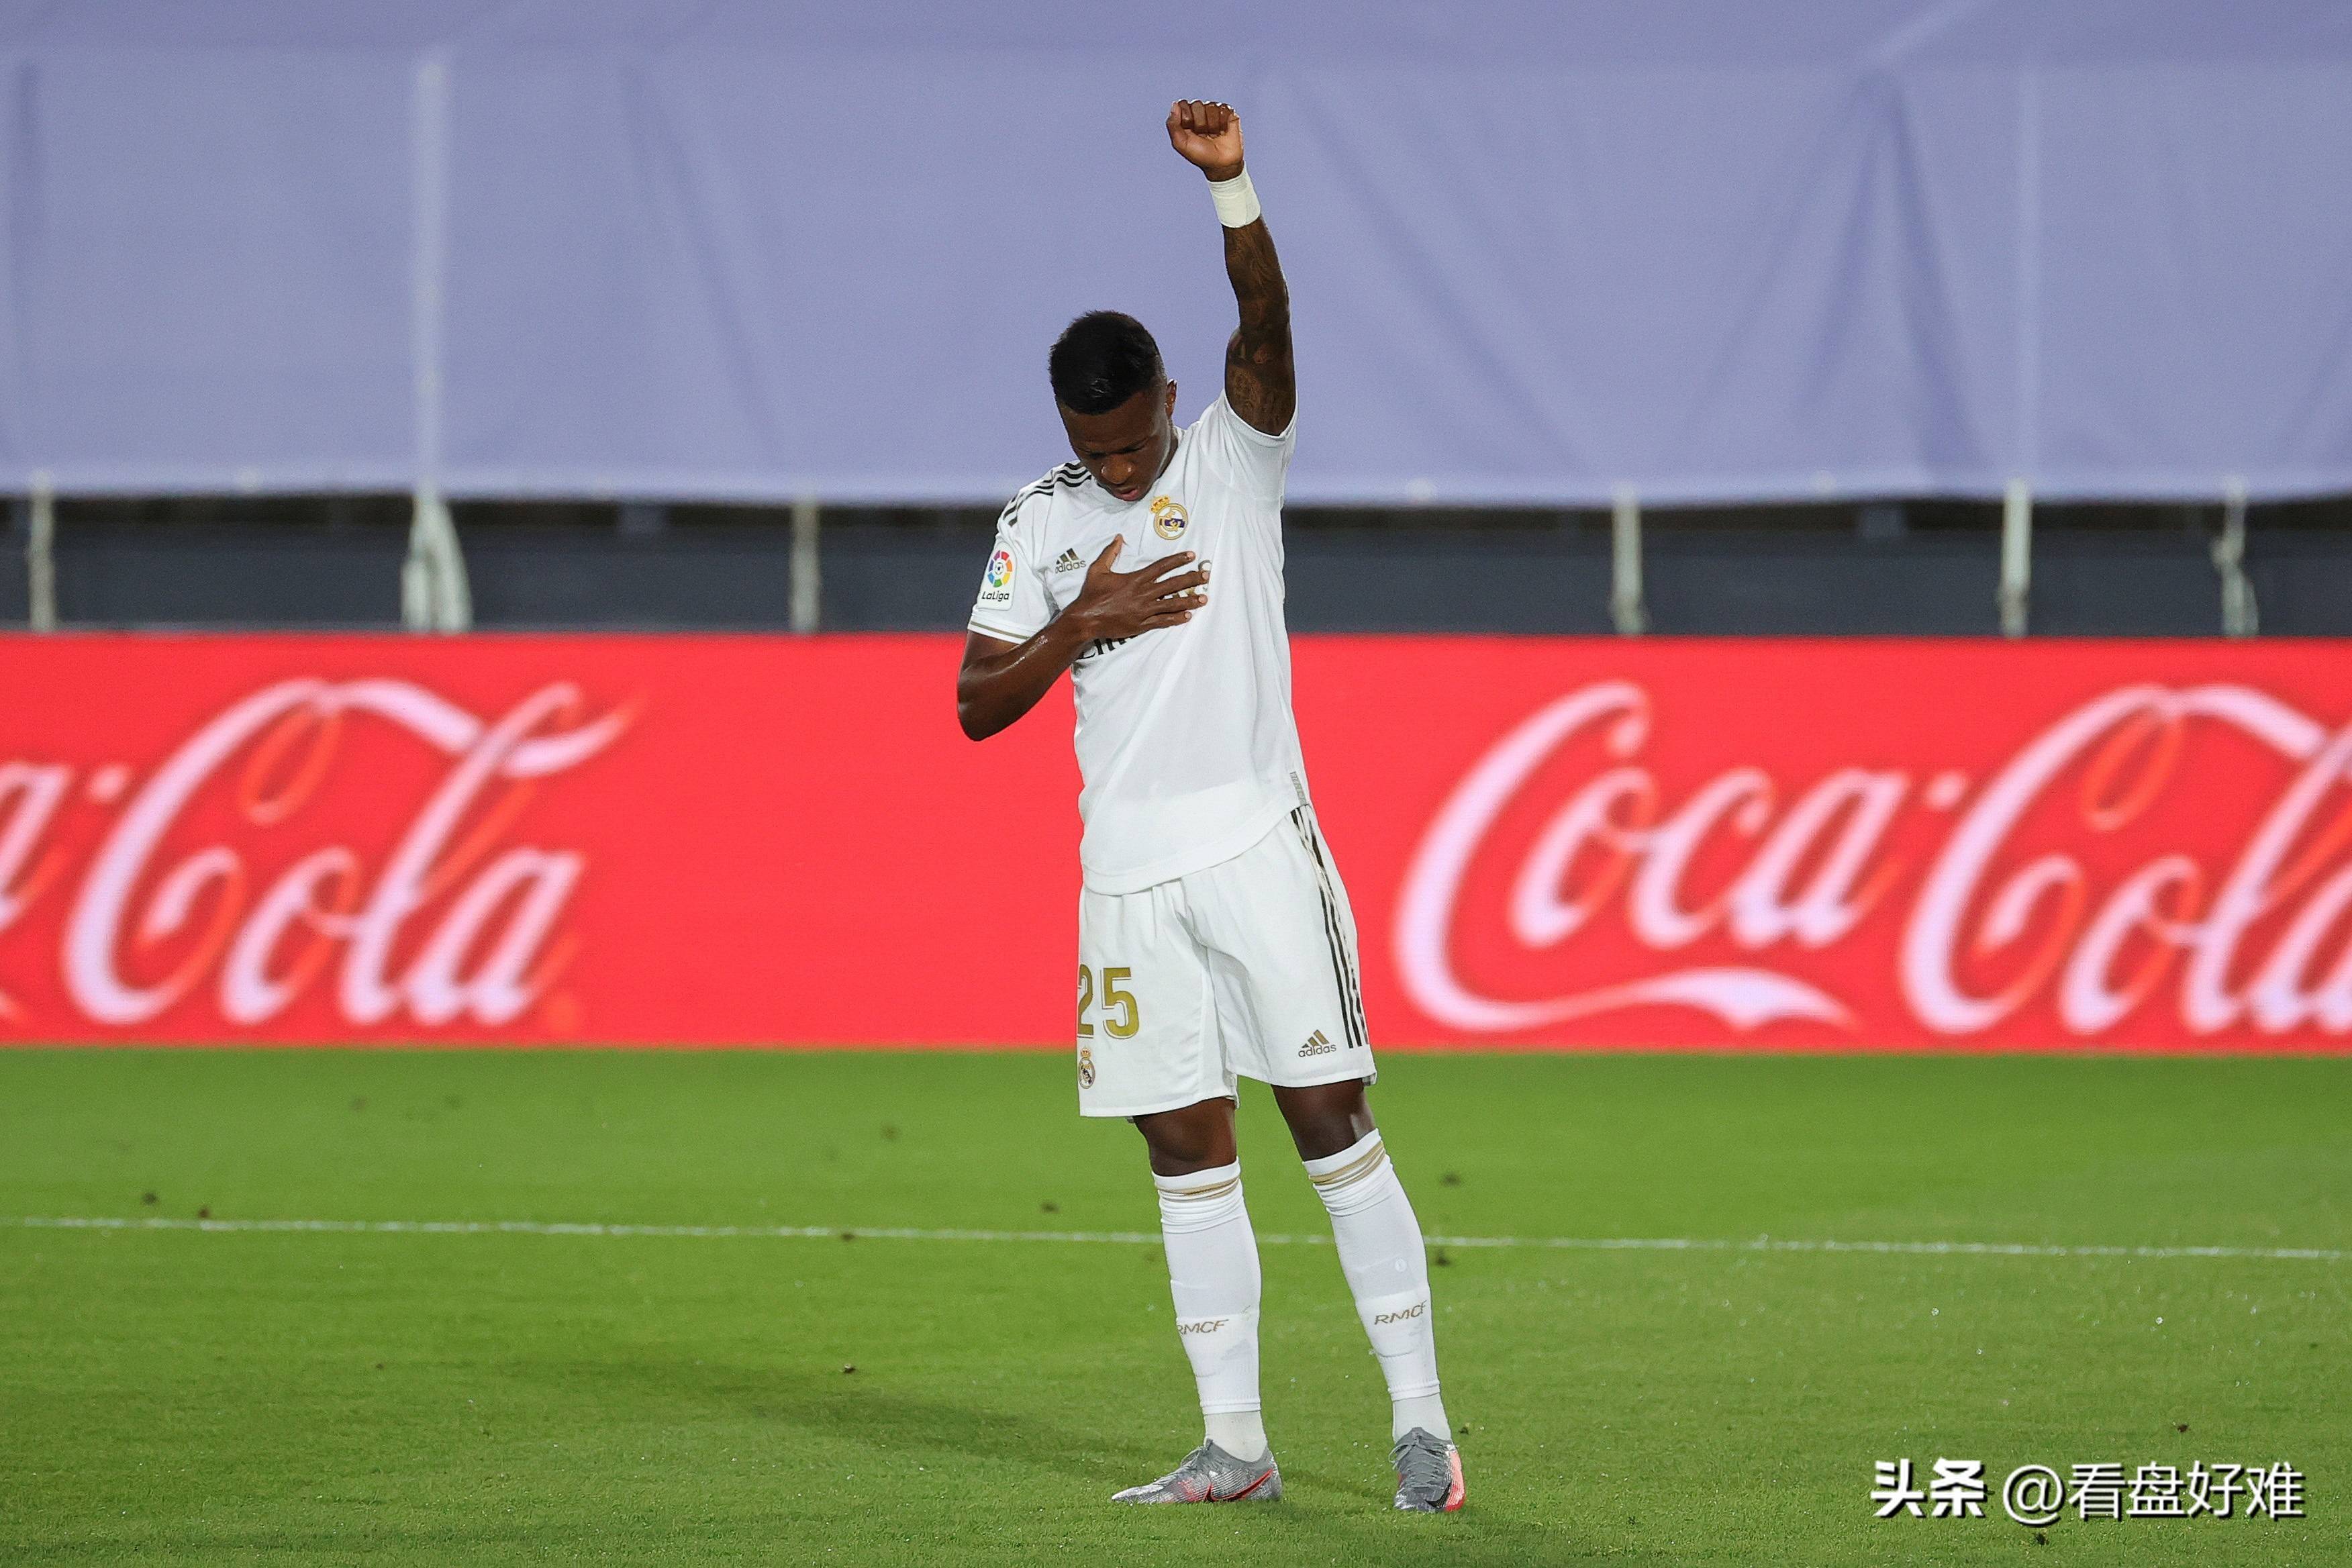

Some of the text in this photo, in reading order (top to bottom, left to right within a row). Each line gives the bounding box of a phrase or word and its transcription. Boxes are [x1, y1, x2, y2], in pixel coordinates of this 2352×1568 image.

[1055, 560, 1086, 574] adidas
[981, 591, 1010, 601] LaLiga
[1077, 964, 1140, 1039] 25
[1298, 1044, 1336, 1057] adidas
[1374, 1300, 1427, 1325] RMCF
